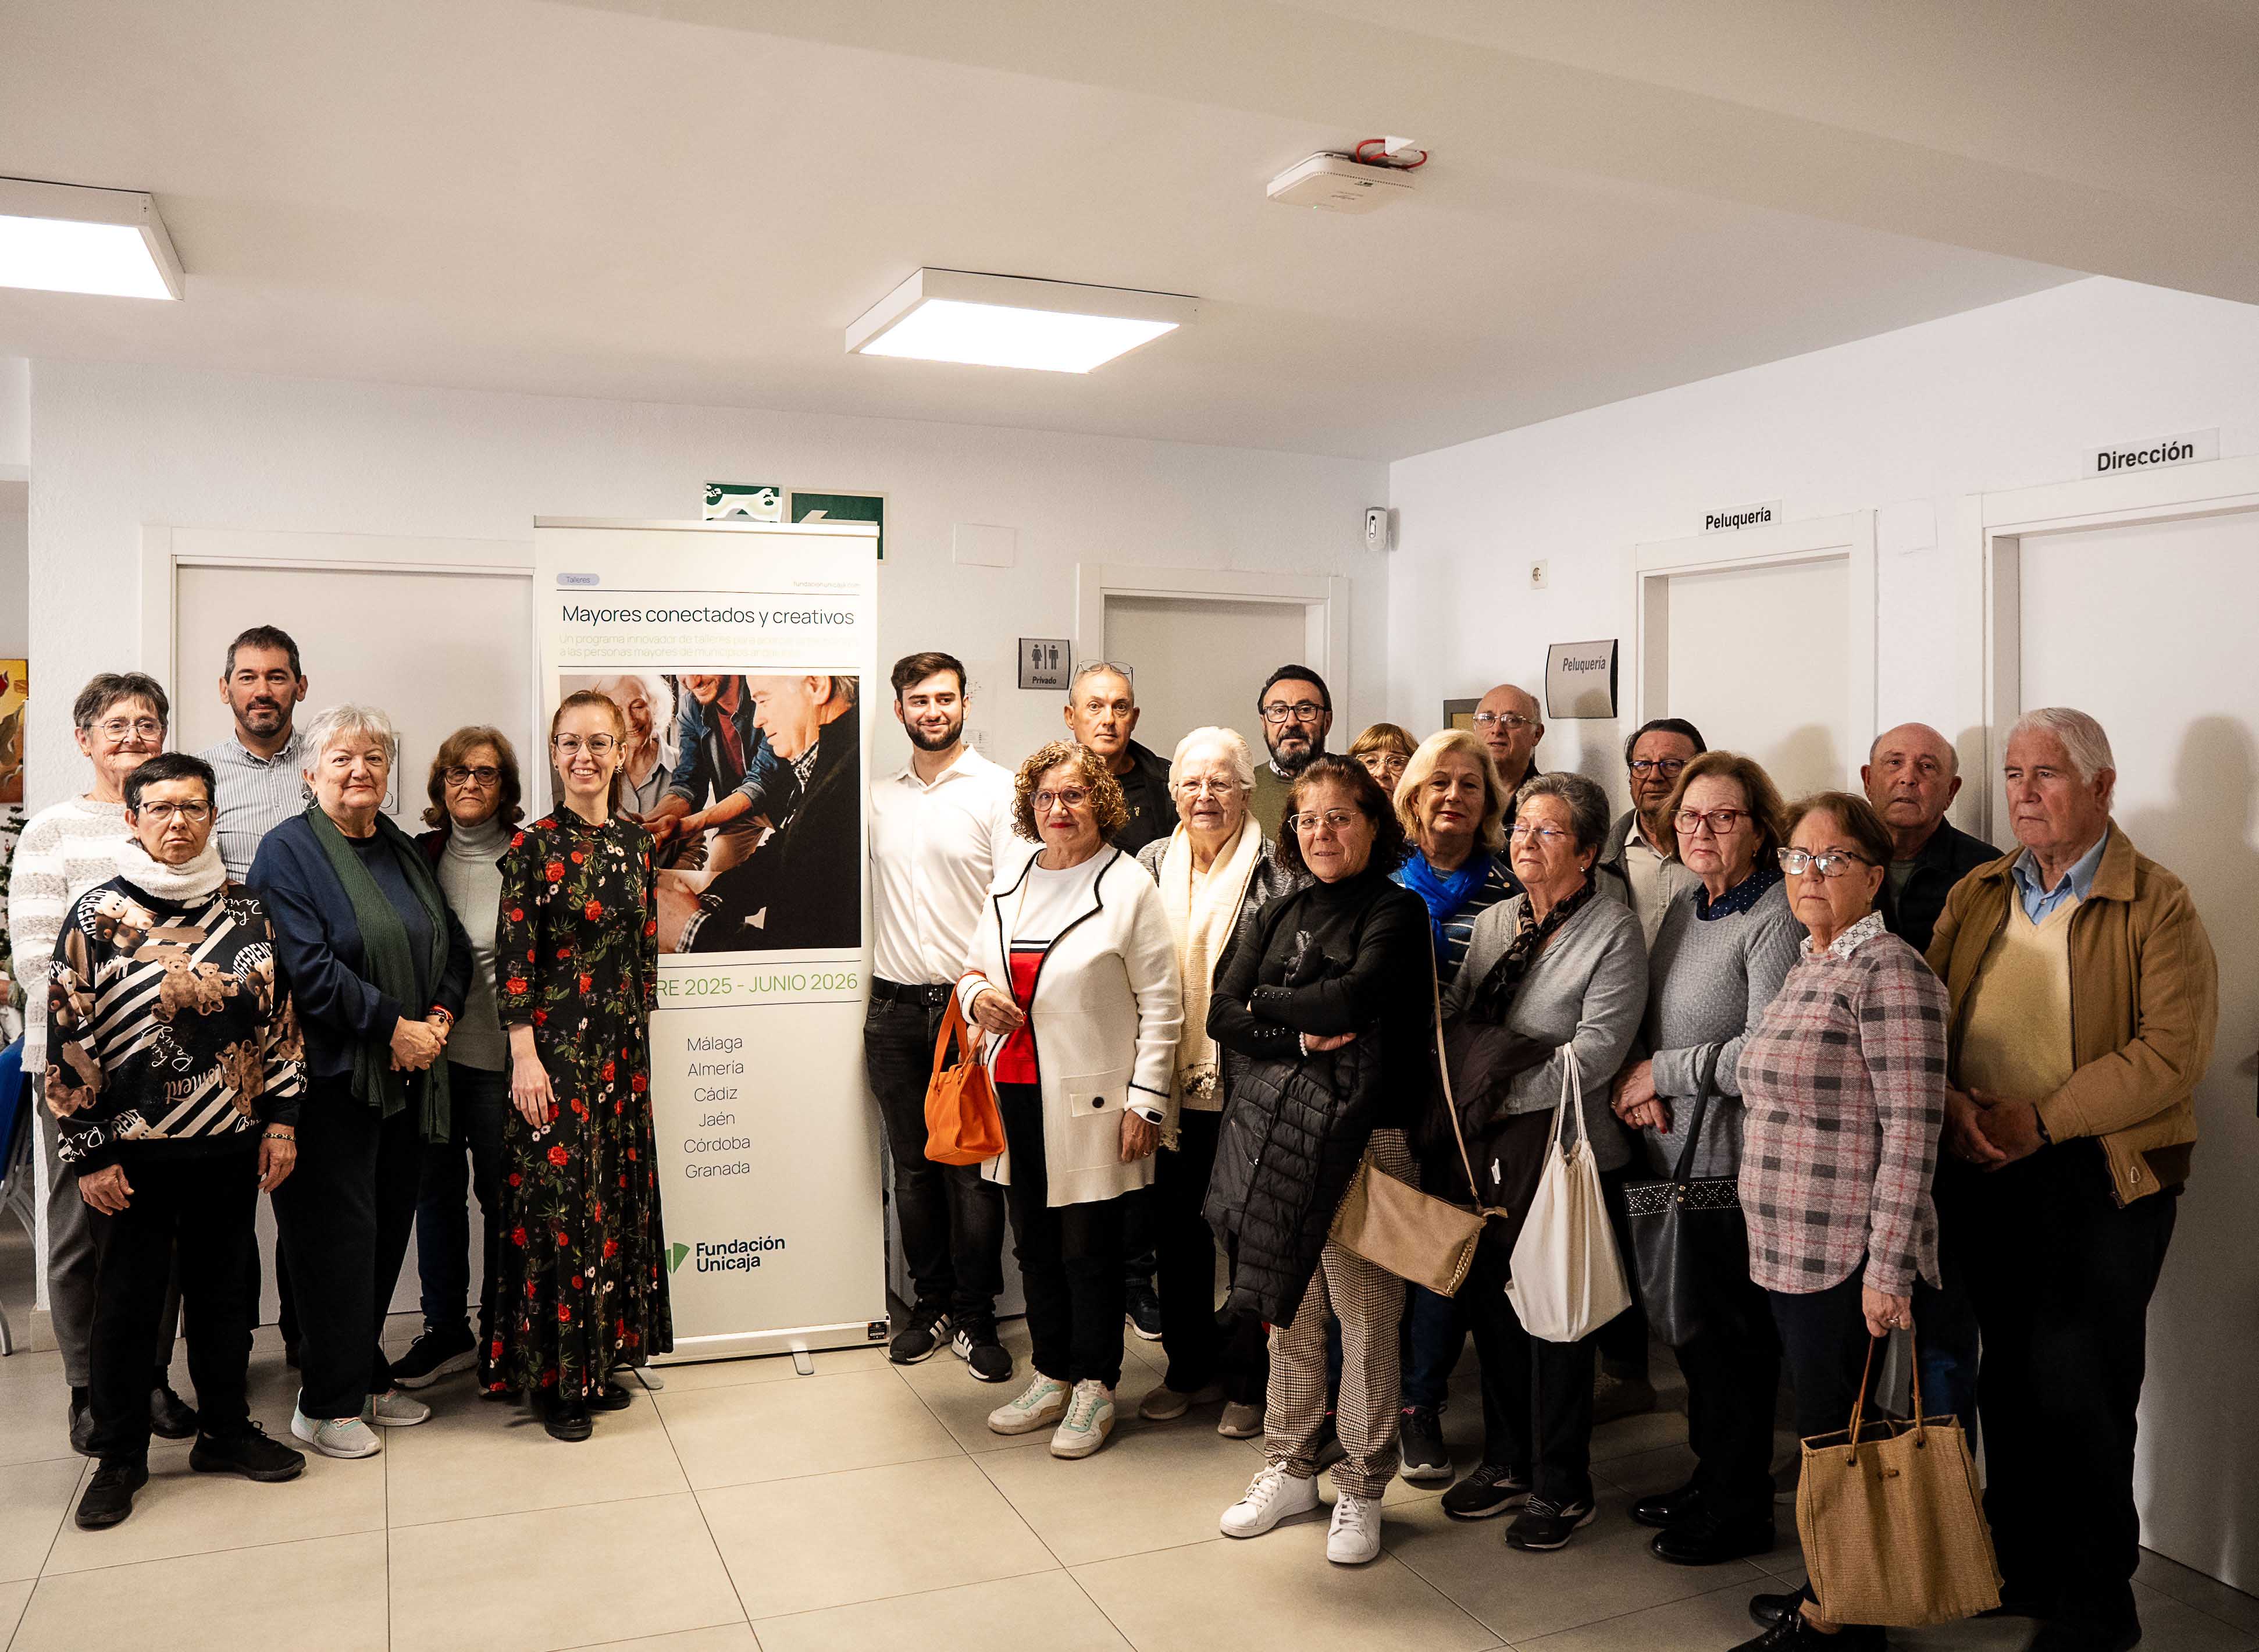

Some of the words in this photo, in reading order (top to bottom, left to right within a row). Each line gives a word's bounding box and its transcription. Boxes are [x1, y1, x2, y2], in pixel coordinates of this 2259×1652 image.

[2097, 441, 2194, 472] Dirección
[1705, 507, 1772, 530] Peluquería
[563, 605, 642, 626] Mayores
[646, 607, 755, 623] conectados
[758, 611, 769, 628] y
[772, 609, 854, 625] creativos
[1562, 656, 1606, 674] Peluquería
[1032, 676, 1057, 685] Privado
[685, 977, 732, 996] 2025
[749, 974, 806, 993] JUNIO
[811, 973, 858, 990] 2026
[687, 1035, 743, 1053] Málaga
[687, 1060, 744, 1077] Almería
[694, 1085, 738, 1102] Cádiz
[699, 1111, 735, 1127] Jaén
[684, 1136, 750, 1153] Córdoba
[685, 1160, 750, 1179] Granada
[696, 1235, 785, 1257] Fundación
[696, 1254, 761, 1273] Unicaja
